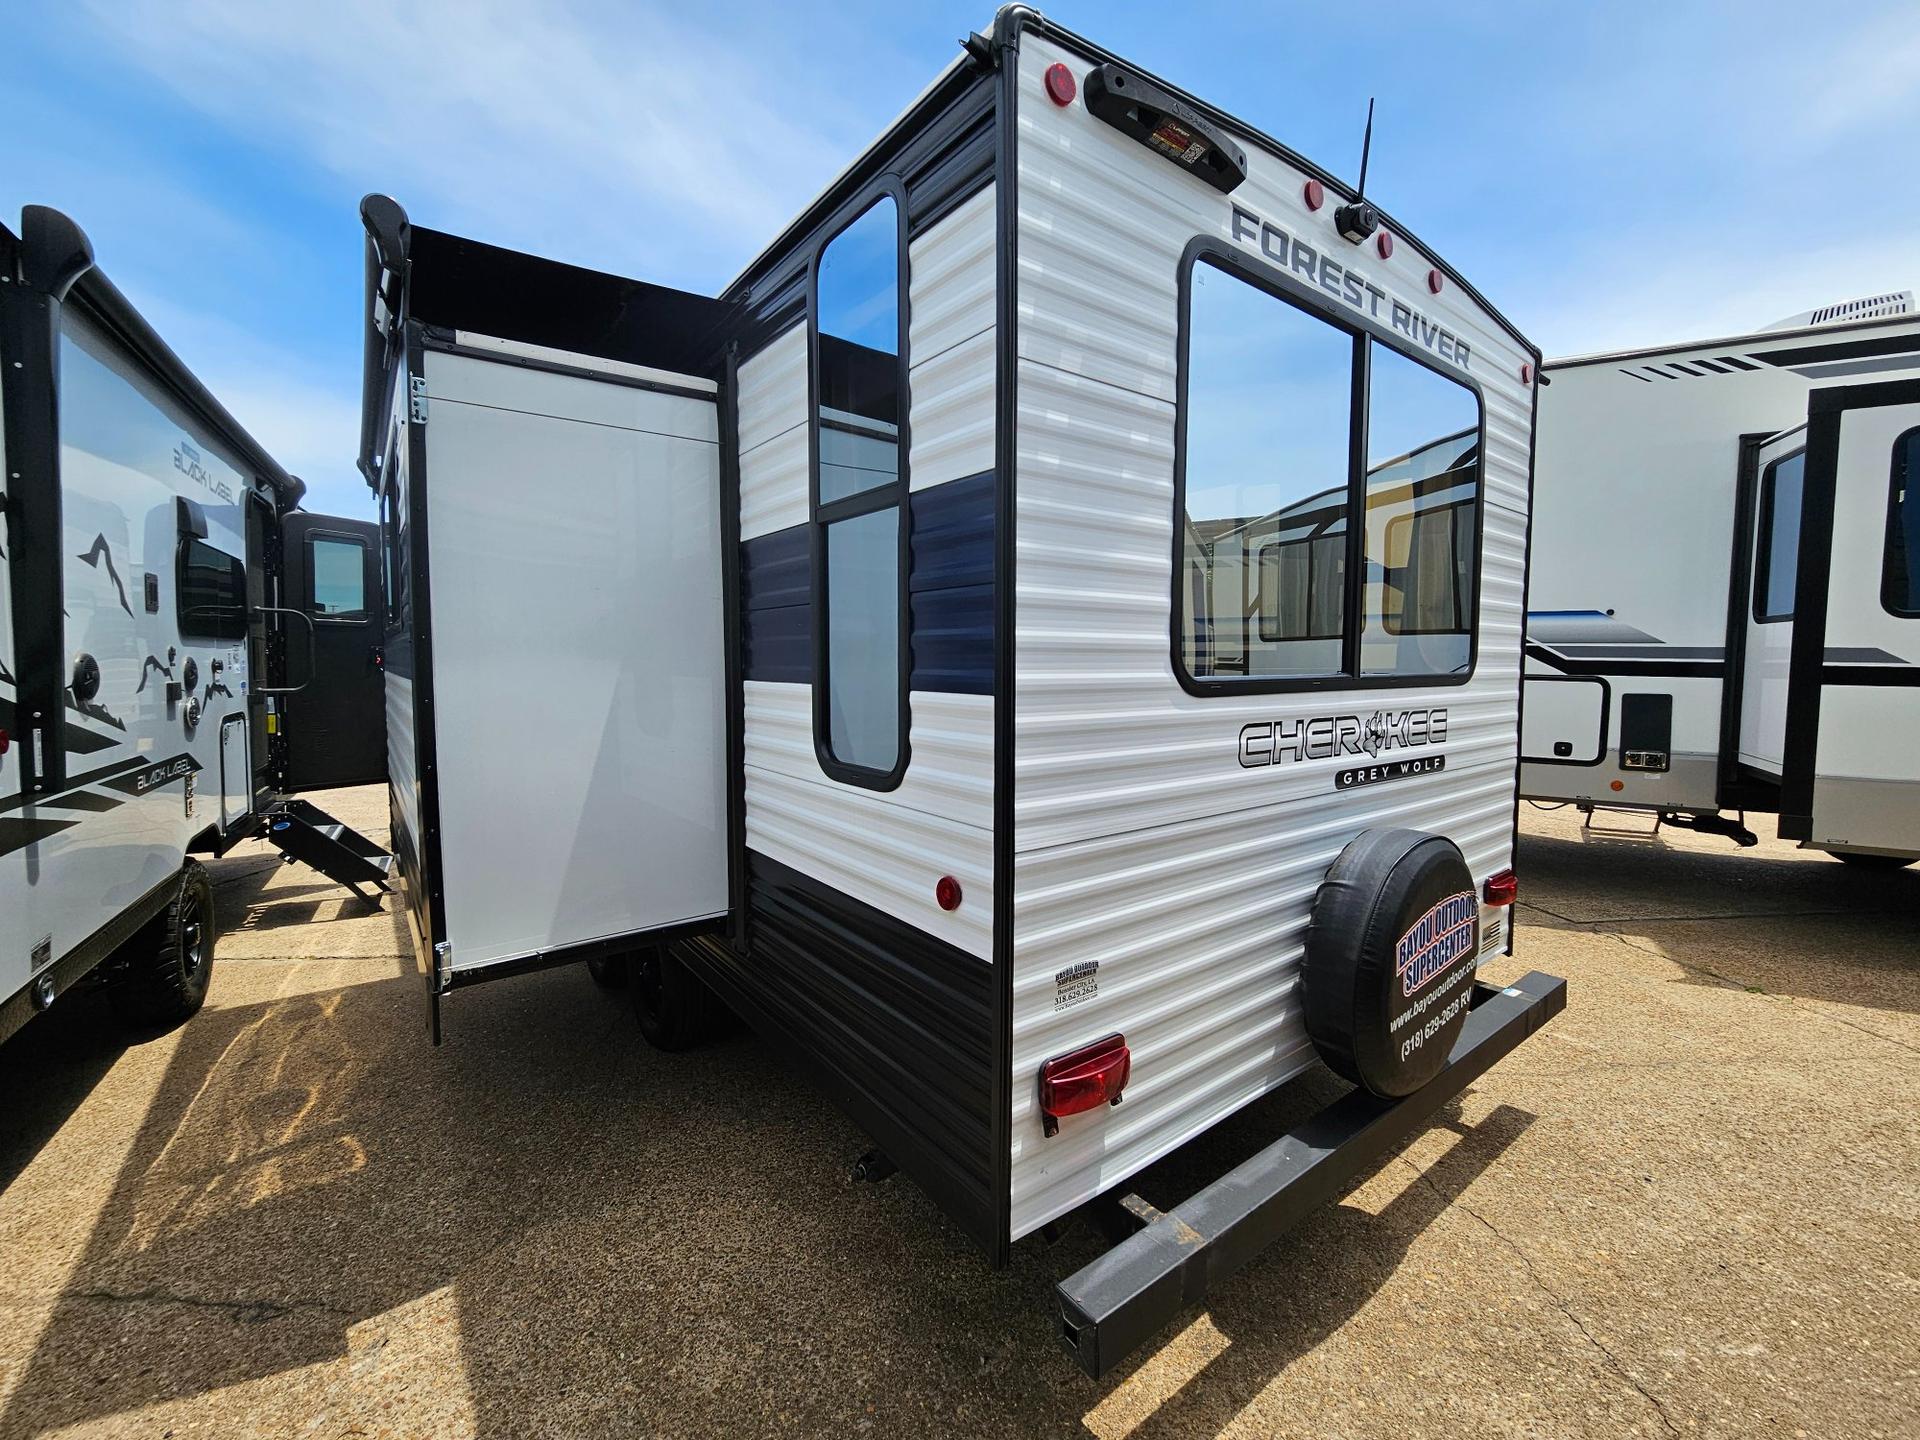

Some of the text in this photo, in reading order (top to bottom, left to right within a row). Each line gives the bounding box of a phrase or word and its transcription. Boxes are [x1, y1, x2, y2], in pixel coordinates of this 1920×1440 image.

[1230, 200, 1470, 370] FOREST RIVER
[173, 447, 207, 488] BLACK
[208, 473, 236, 506] LABEL
[137, 758, 190, 790] BLACK LABEL
[1343, 757, 1441, 785] GREY WOLF
[1398, 911, 1433, 970] BAYOU
[1405, 922, 1473, 993] SUPERCENTER
[1054, 984, 1098, 1005] 318.629.2628
[1055, 967, 1074, 981] BAYOU
[1401, 986, 1472, 1062] (318) 629-2628 RV
